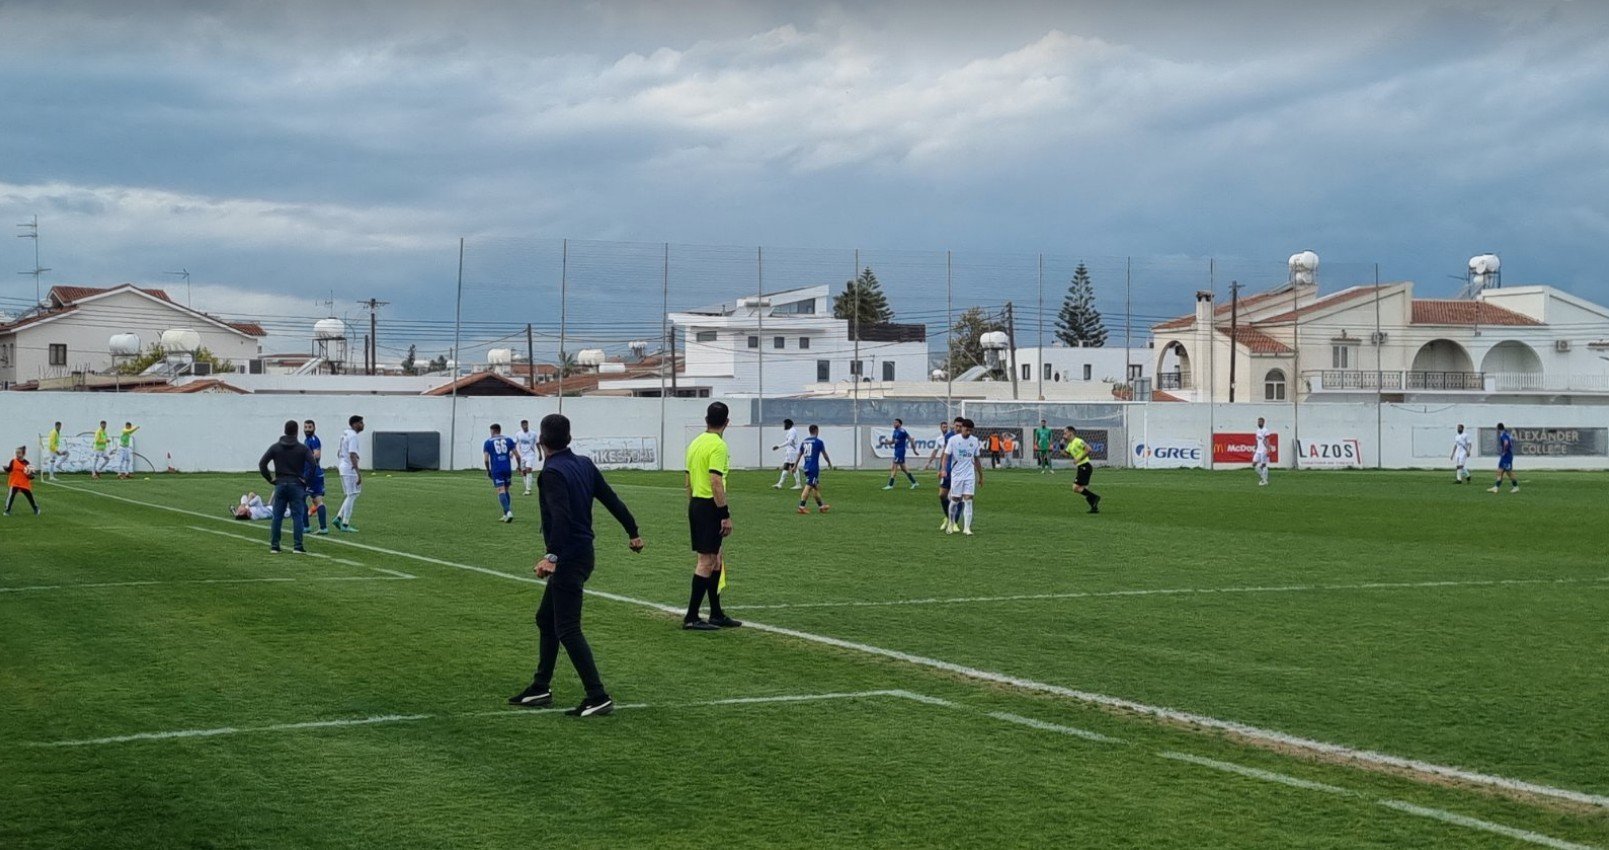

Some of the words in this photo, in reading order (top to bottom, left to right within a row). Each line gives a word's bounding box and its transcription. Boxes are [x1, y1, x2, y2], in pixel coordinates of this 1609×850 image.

[494, 439, 508, 454] 66
[1154, 447, 1201, 459] GREE
[1297, 440, 1353, 458] LAZOS
